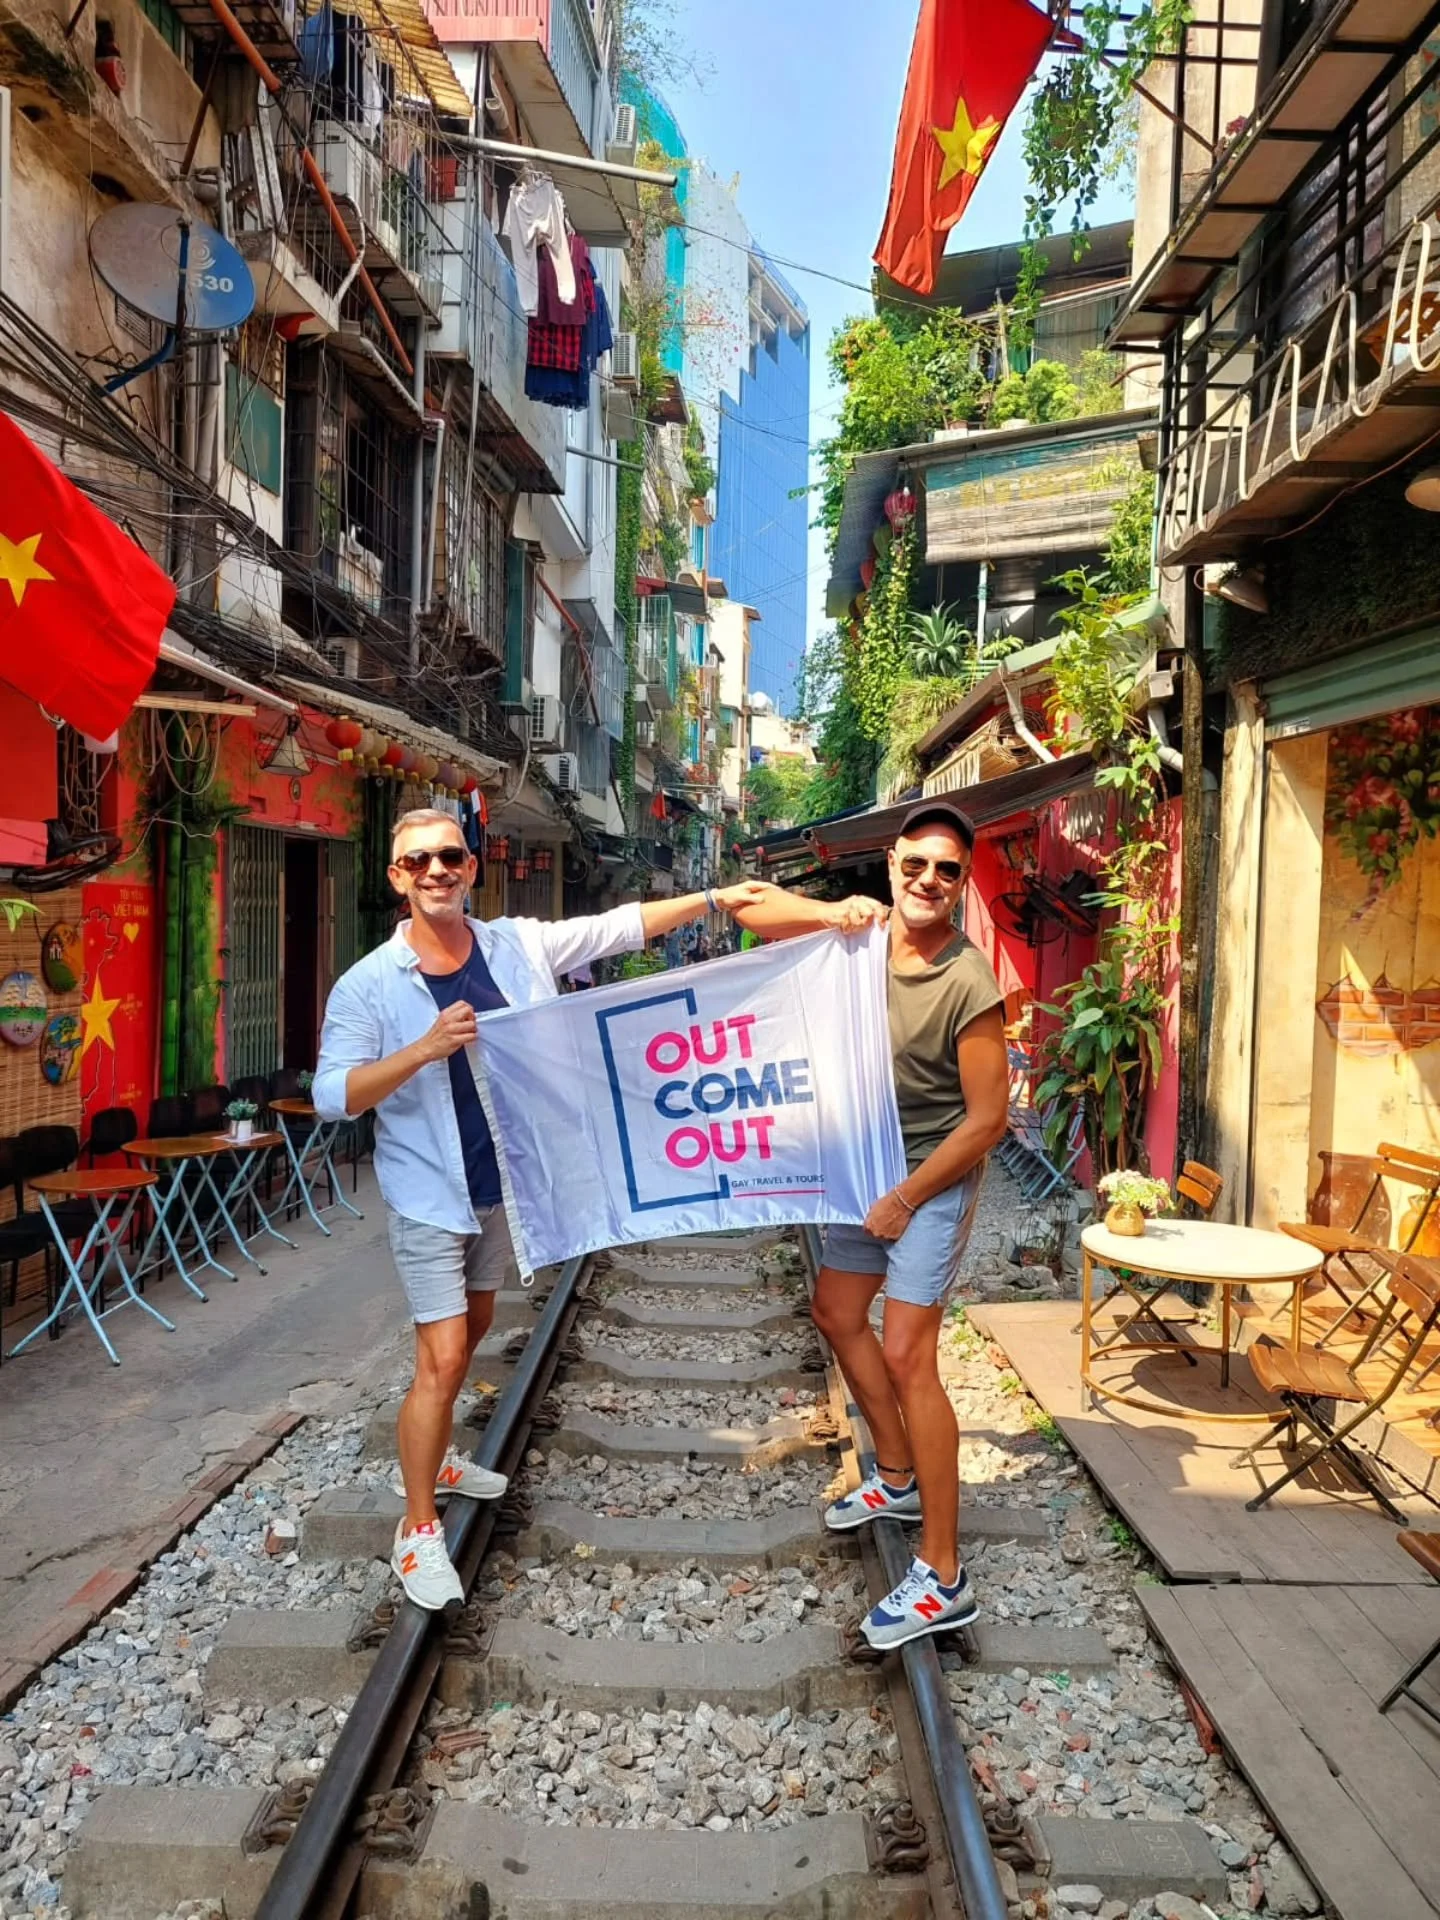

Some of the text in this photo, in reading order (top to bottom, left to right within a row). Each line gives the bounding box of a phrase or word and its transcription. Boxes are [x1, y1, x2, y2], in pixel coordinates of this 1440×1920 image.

[645, 1014, 756, 1074] OUT
[654, 1058, 814, 1119] COME
[665, 1116, 775, 1168] OUT
[731, 1174, 825, 1188] GAY TRAVEL & TOURS
[437, 1465, 464, 1486] N
[862, 1489, 887, 1509] N
[401, 1551, 419, 1576] N
[913, 1593, 943, 1621] N
